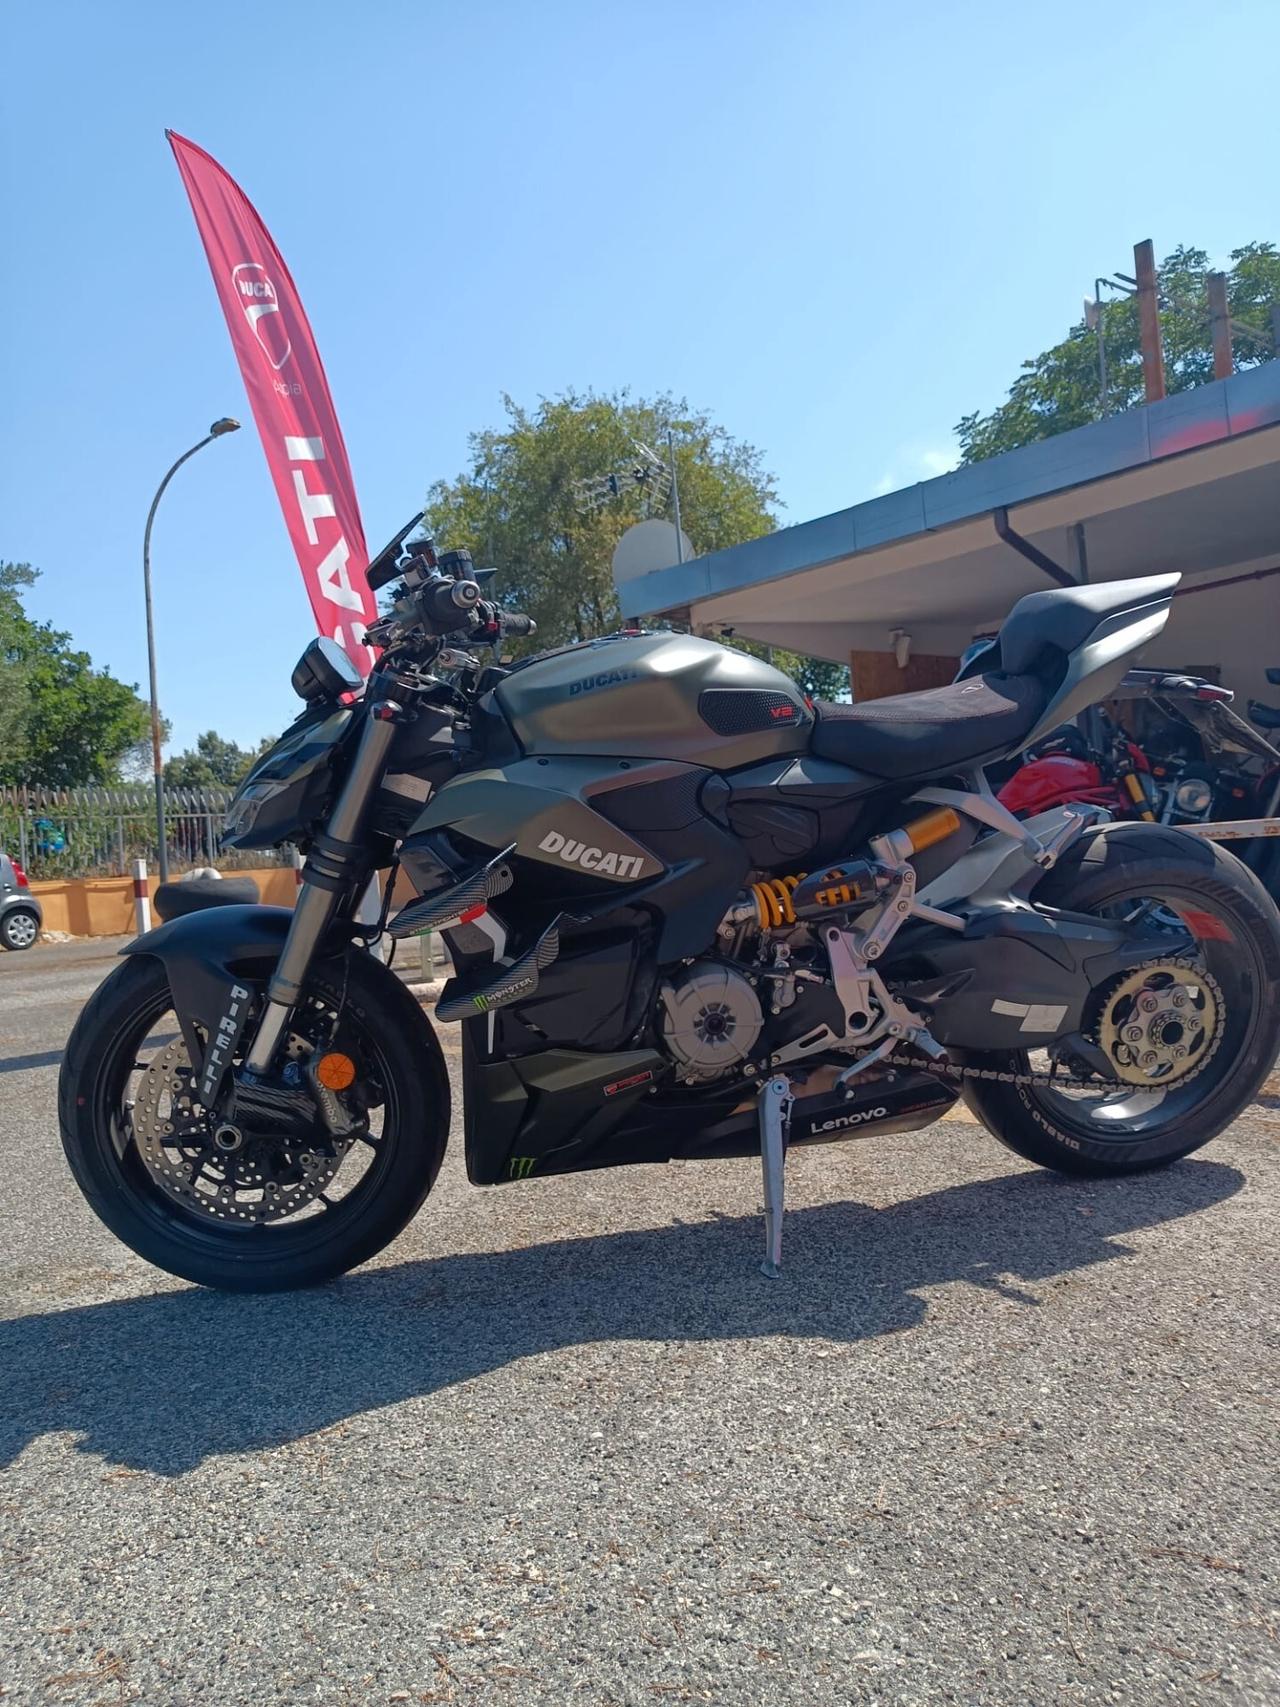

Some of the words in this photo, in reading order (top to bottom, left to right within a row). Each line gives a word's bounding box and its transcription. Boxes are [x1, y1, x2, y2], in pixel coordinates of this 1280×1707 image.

[538, 830, 645, 878] DUCATI
[486, 976, 534, 1002] MONSTER
[203, 984, 249, 1095] PIRELLI
[811, 1106, 888, 1134] Lenovo
[1031, 1110, 1081, 1151] DIABLO
